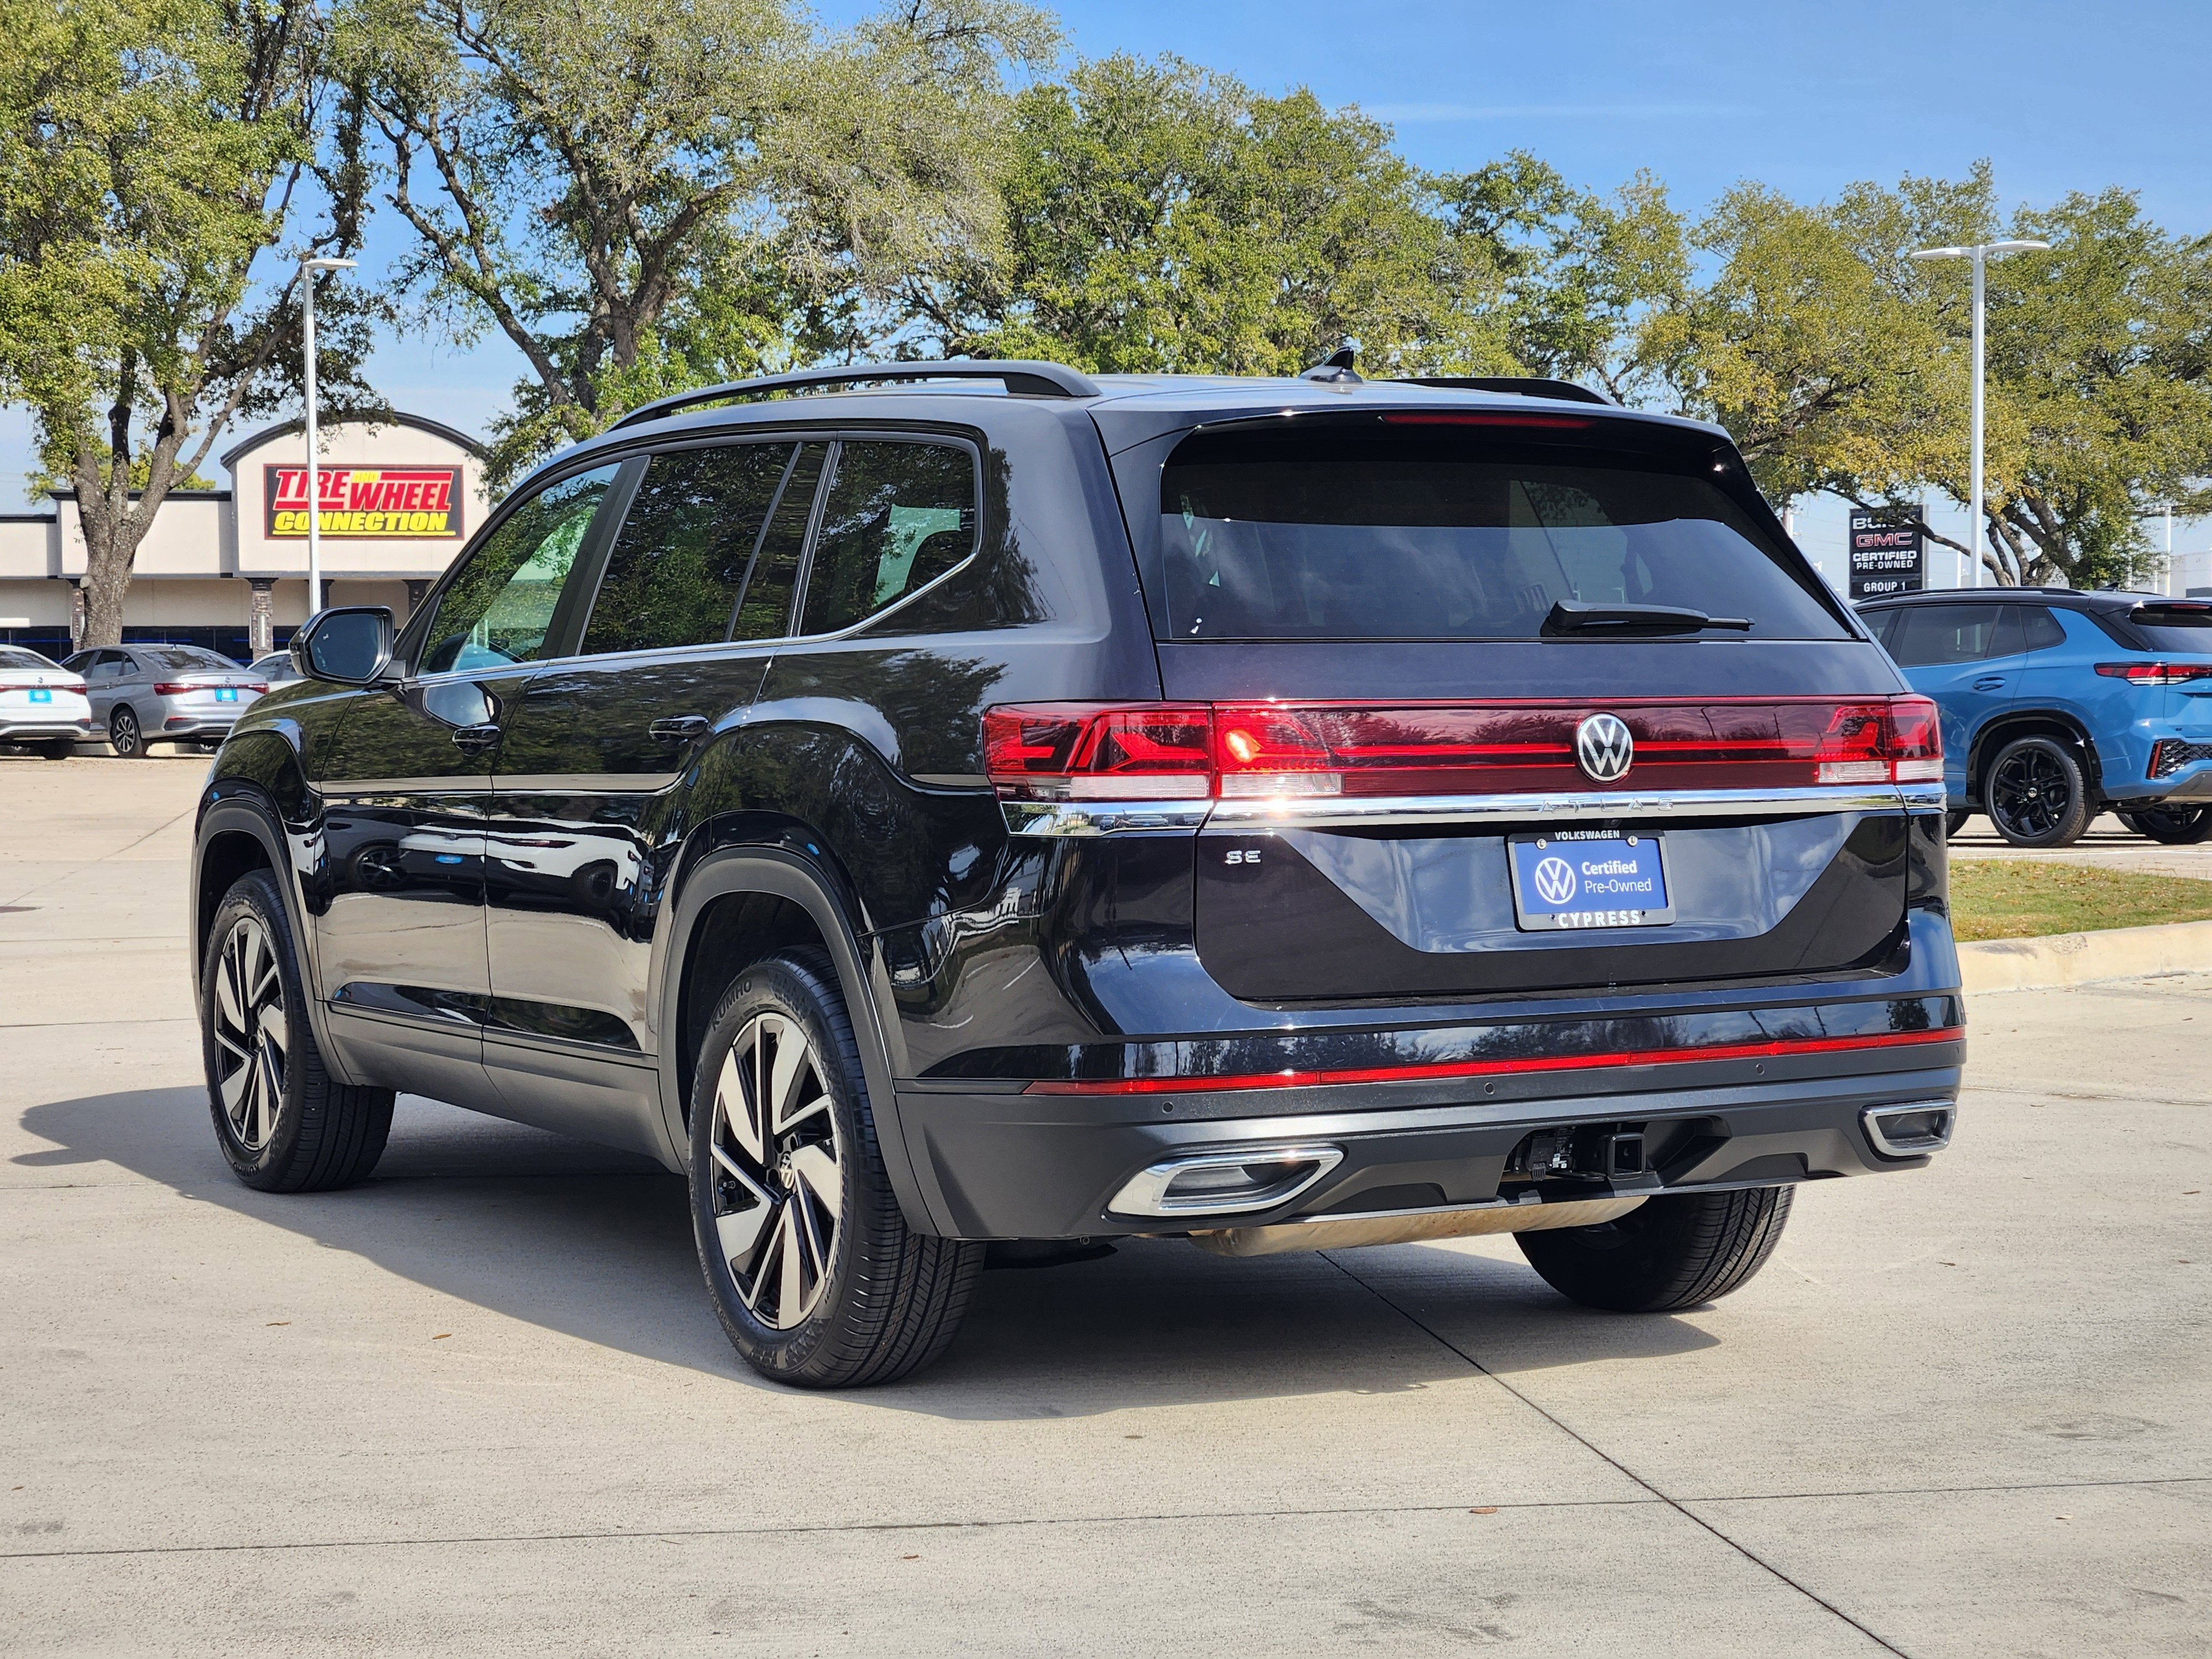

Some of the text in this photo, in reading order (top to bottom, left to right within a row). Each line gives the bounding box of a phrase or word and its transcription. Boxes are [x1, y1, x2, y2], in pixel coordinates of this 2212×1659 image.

[276, 471, 351, 498] TIRE
[349, 482, 451, 510] WHEEL
[274, 512, 448, 531] CONNECTION
[1856, 532, 1913, 547] GMC
[1853, 550, 1917, 562] CERTIFIED
[1856, 560, 1913, 570] PRE-OWNED
[1864, 581, 1906, 592] GROUP 1
[1538, 797, 1673, 814] ATLAS
[1554, 830, 1620, 841] VOLKSWAGEN
[1225, 850, 1261, 864] SE
[1582, 860, 1637, 875] Certified
[1584, 878, 1652, 894] Pre-Owned
[1558, 910, 1641, 928] CYPRESS
[712, 978, 753, 1032] KUMHO
[233, 1161, 261, 1177] KUMHO
